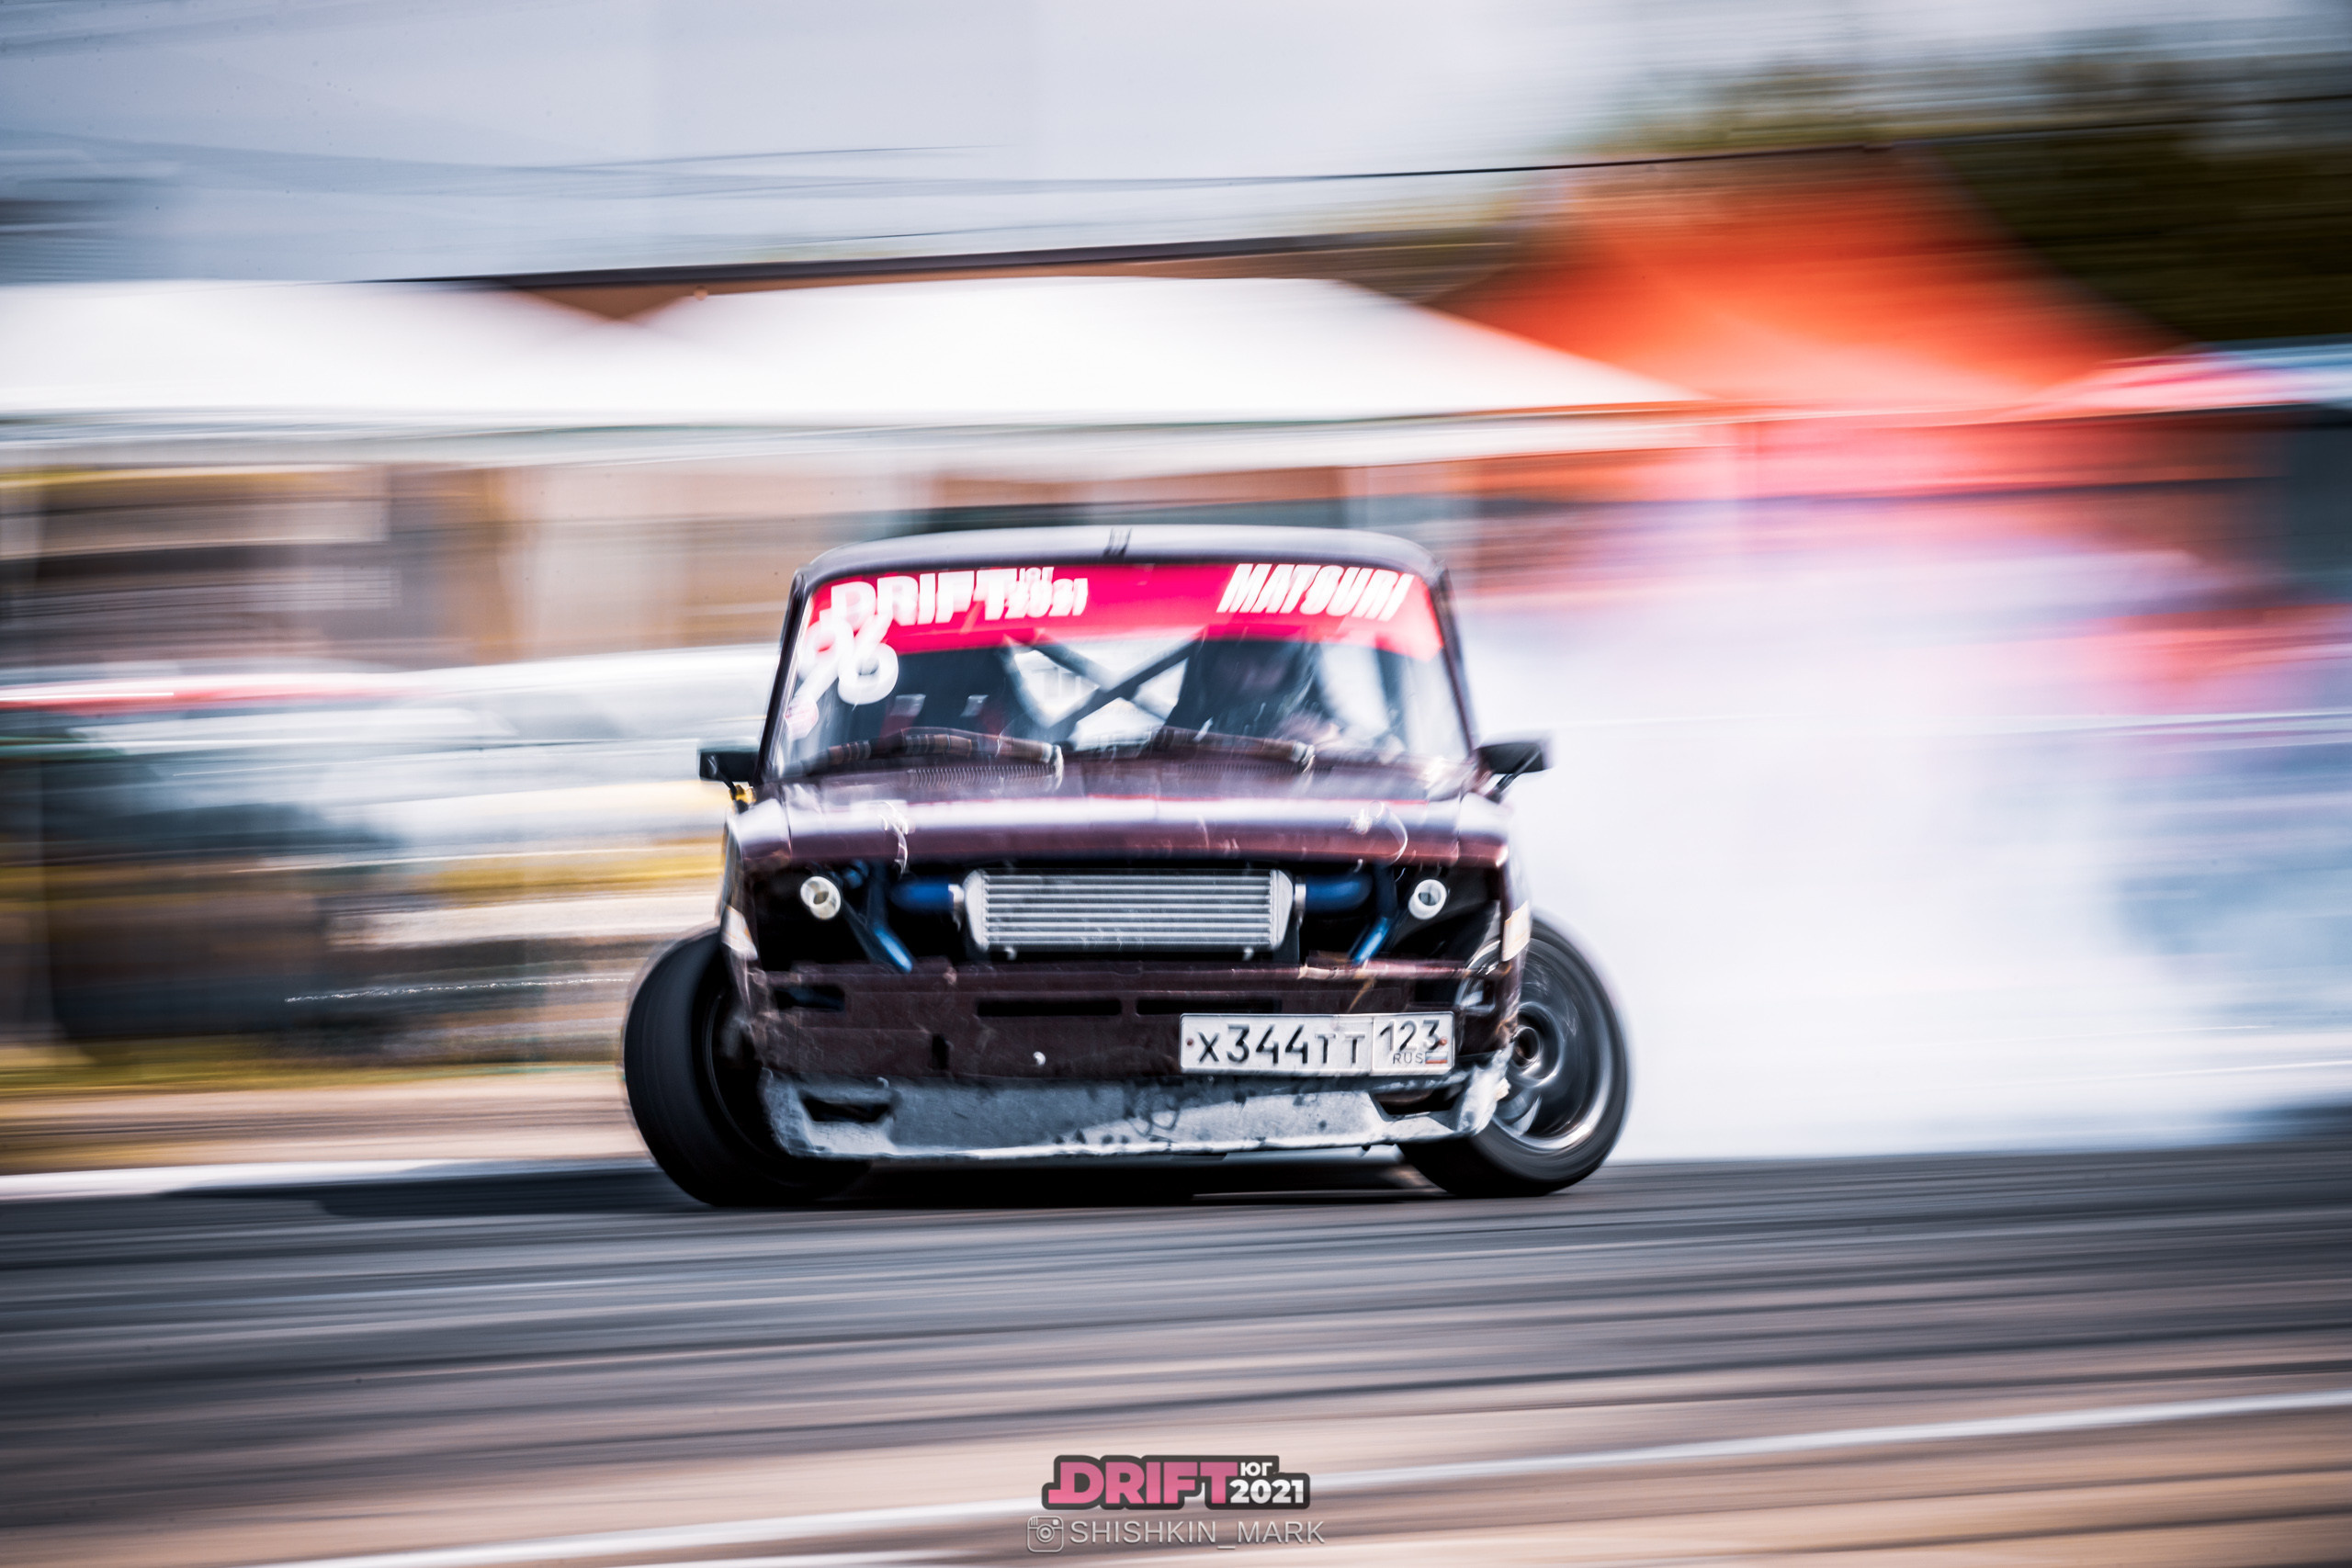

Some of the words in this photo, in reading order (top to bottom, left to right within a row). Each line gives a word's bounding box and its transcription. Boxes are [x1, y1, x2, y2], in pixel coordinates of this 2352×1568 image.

[819, 567, 1017, 631] DRIFT
[1216, 562, 1415, 622] MATSURI
[1379, 1019, 1441, 1051] 123
[1392, 1052, 1424, 1065] RUS
